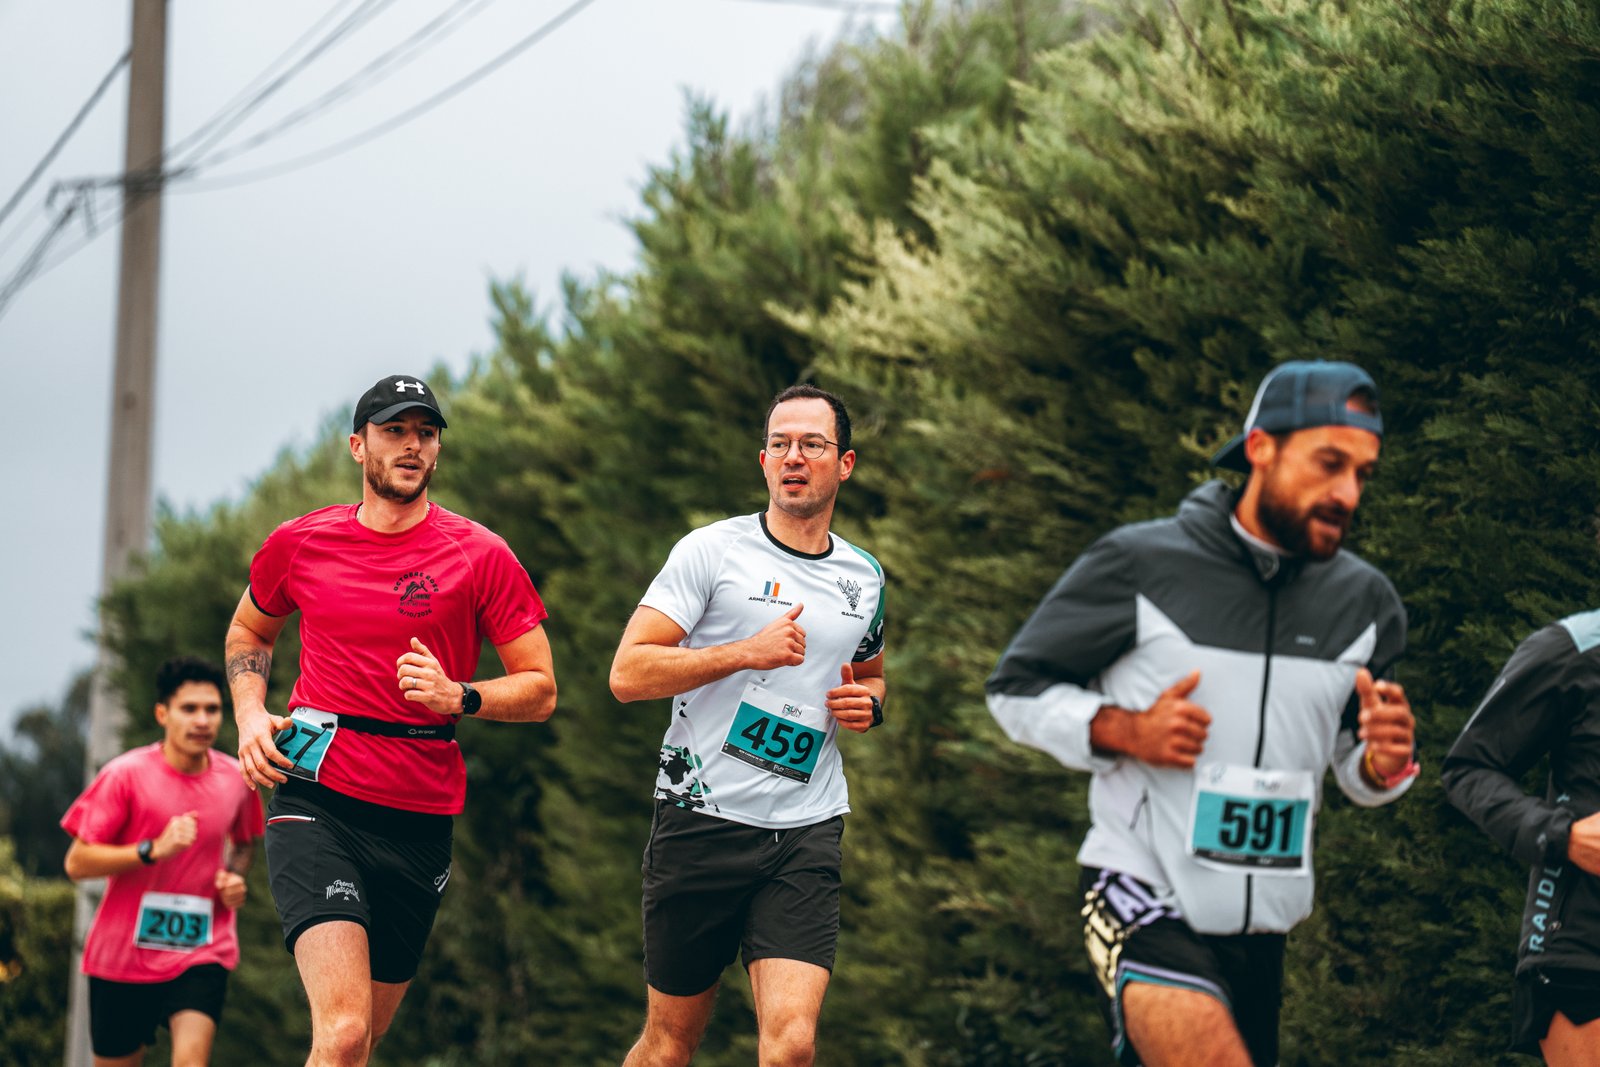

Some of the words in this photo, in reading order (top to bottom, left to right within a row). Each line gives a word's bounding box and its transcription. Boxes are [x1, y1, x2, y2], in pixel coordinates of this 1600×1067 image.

[393, 571, 423, 591] OCTOBRE
[425, 575, 439, 592] ROSE
[740, 716, 815, 765] 459
[1219, 801, 1295, 853] 591
[148, 909, 202, 942] 203
